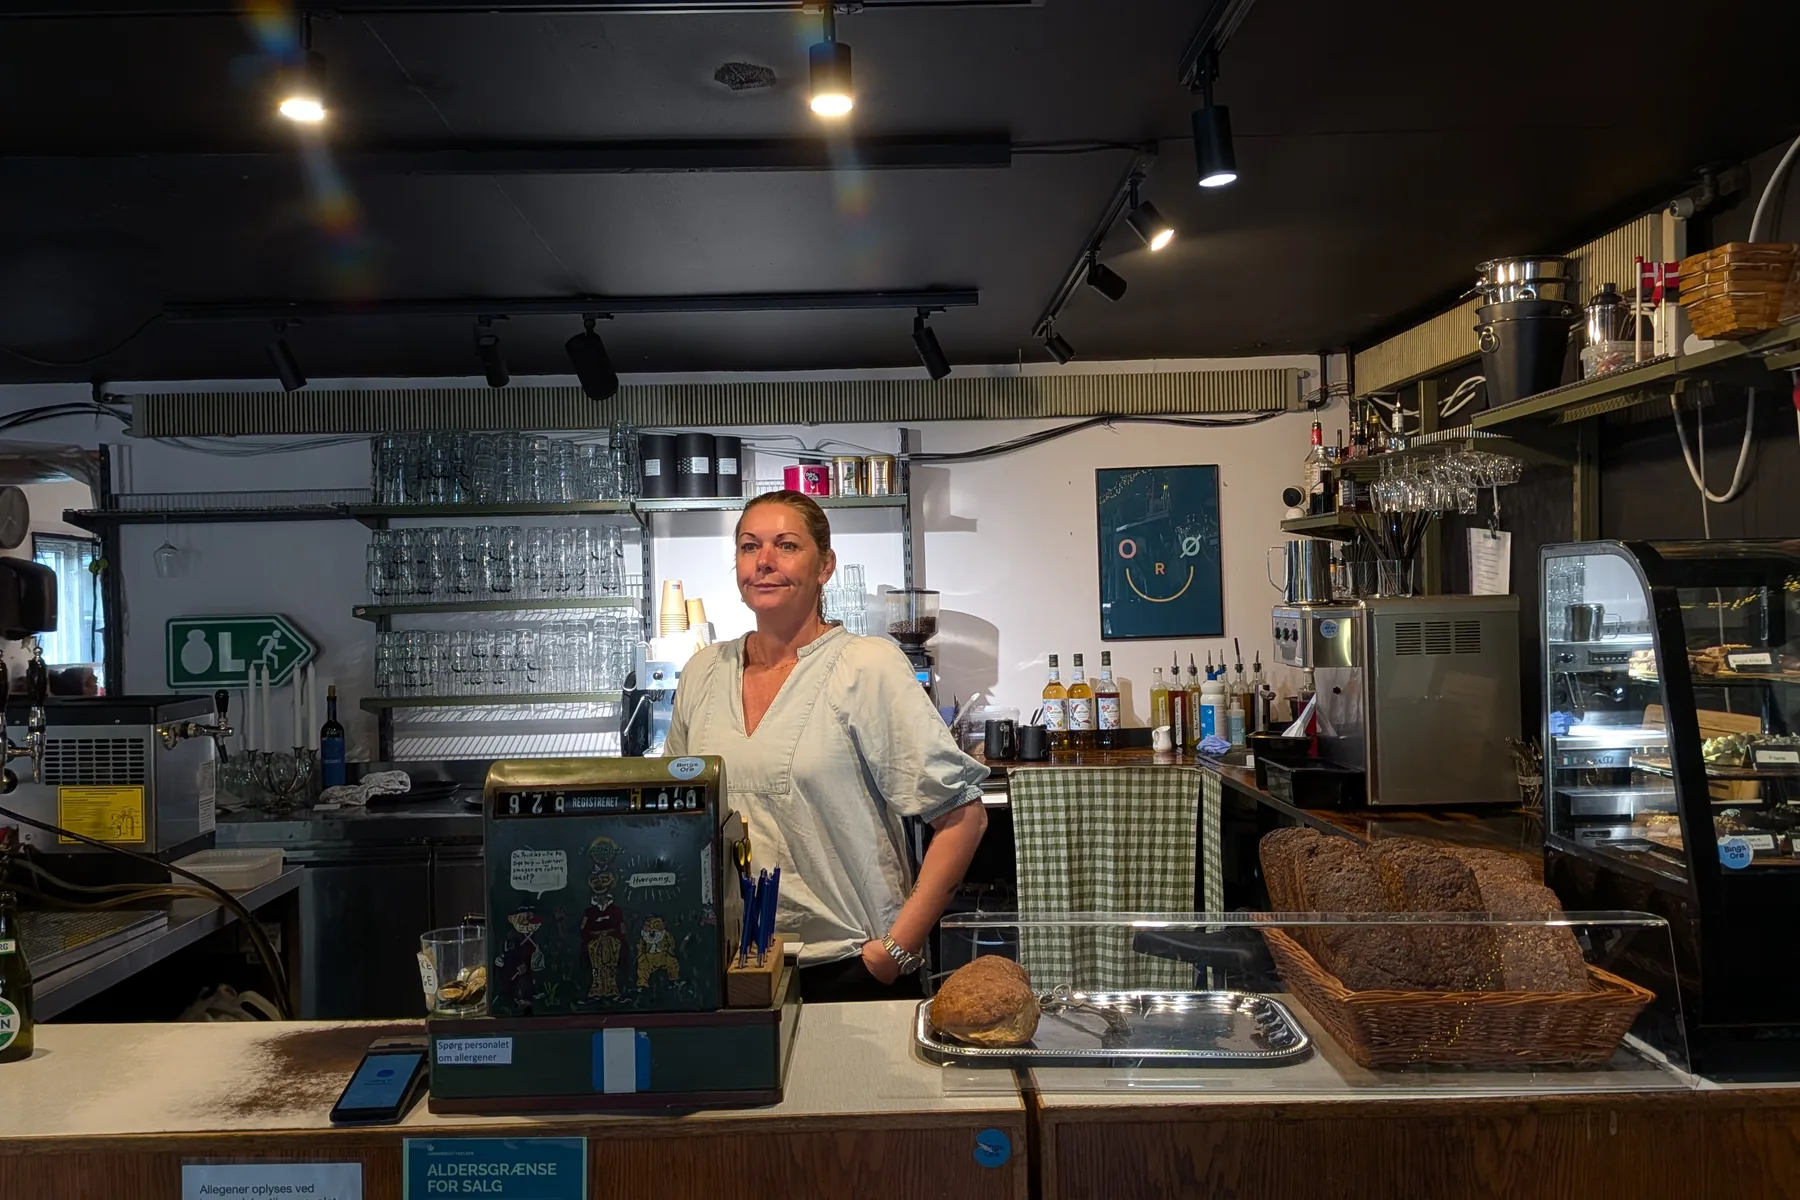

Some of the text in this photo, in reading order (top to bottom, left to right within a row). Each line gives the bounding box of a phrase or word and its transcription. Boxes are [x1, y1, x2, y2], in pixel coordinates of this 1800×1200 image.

[572, 796, 619, 808] REGISTRERET
[1723, 845, 1746, 853] Bings
[438, 1040, 509, 1051] Spørg personalet
[454, 1053, 497, 1063] allergener
[427, 1163, 558, 1177] ALDERSGRÆNSE
[199, 1183, 315, 1197] Allegener oplyses ved
[427, 1180, 503, 1193] FOR SALG
